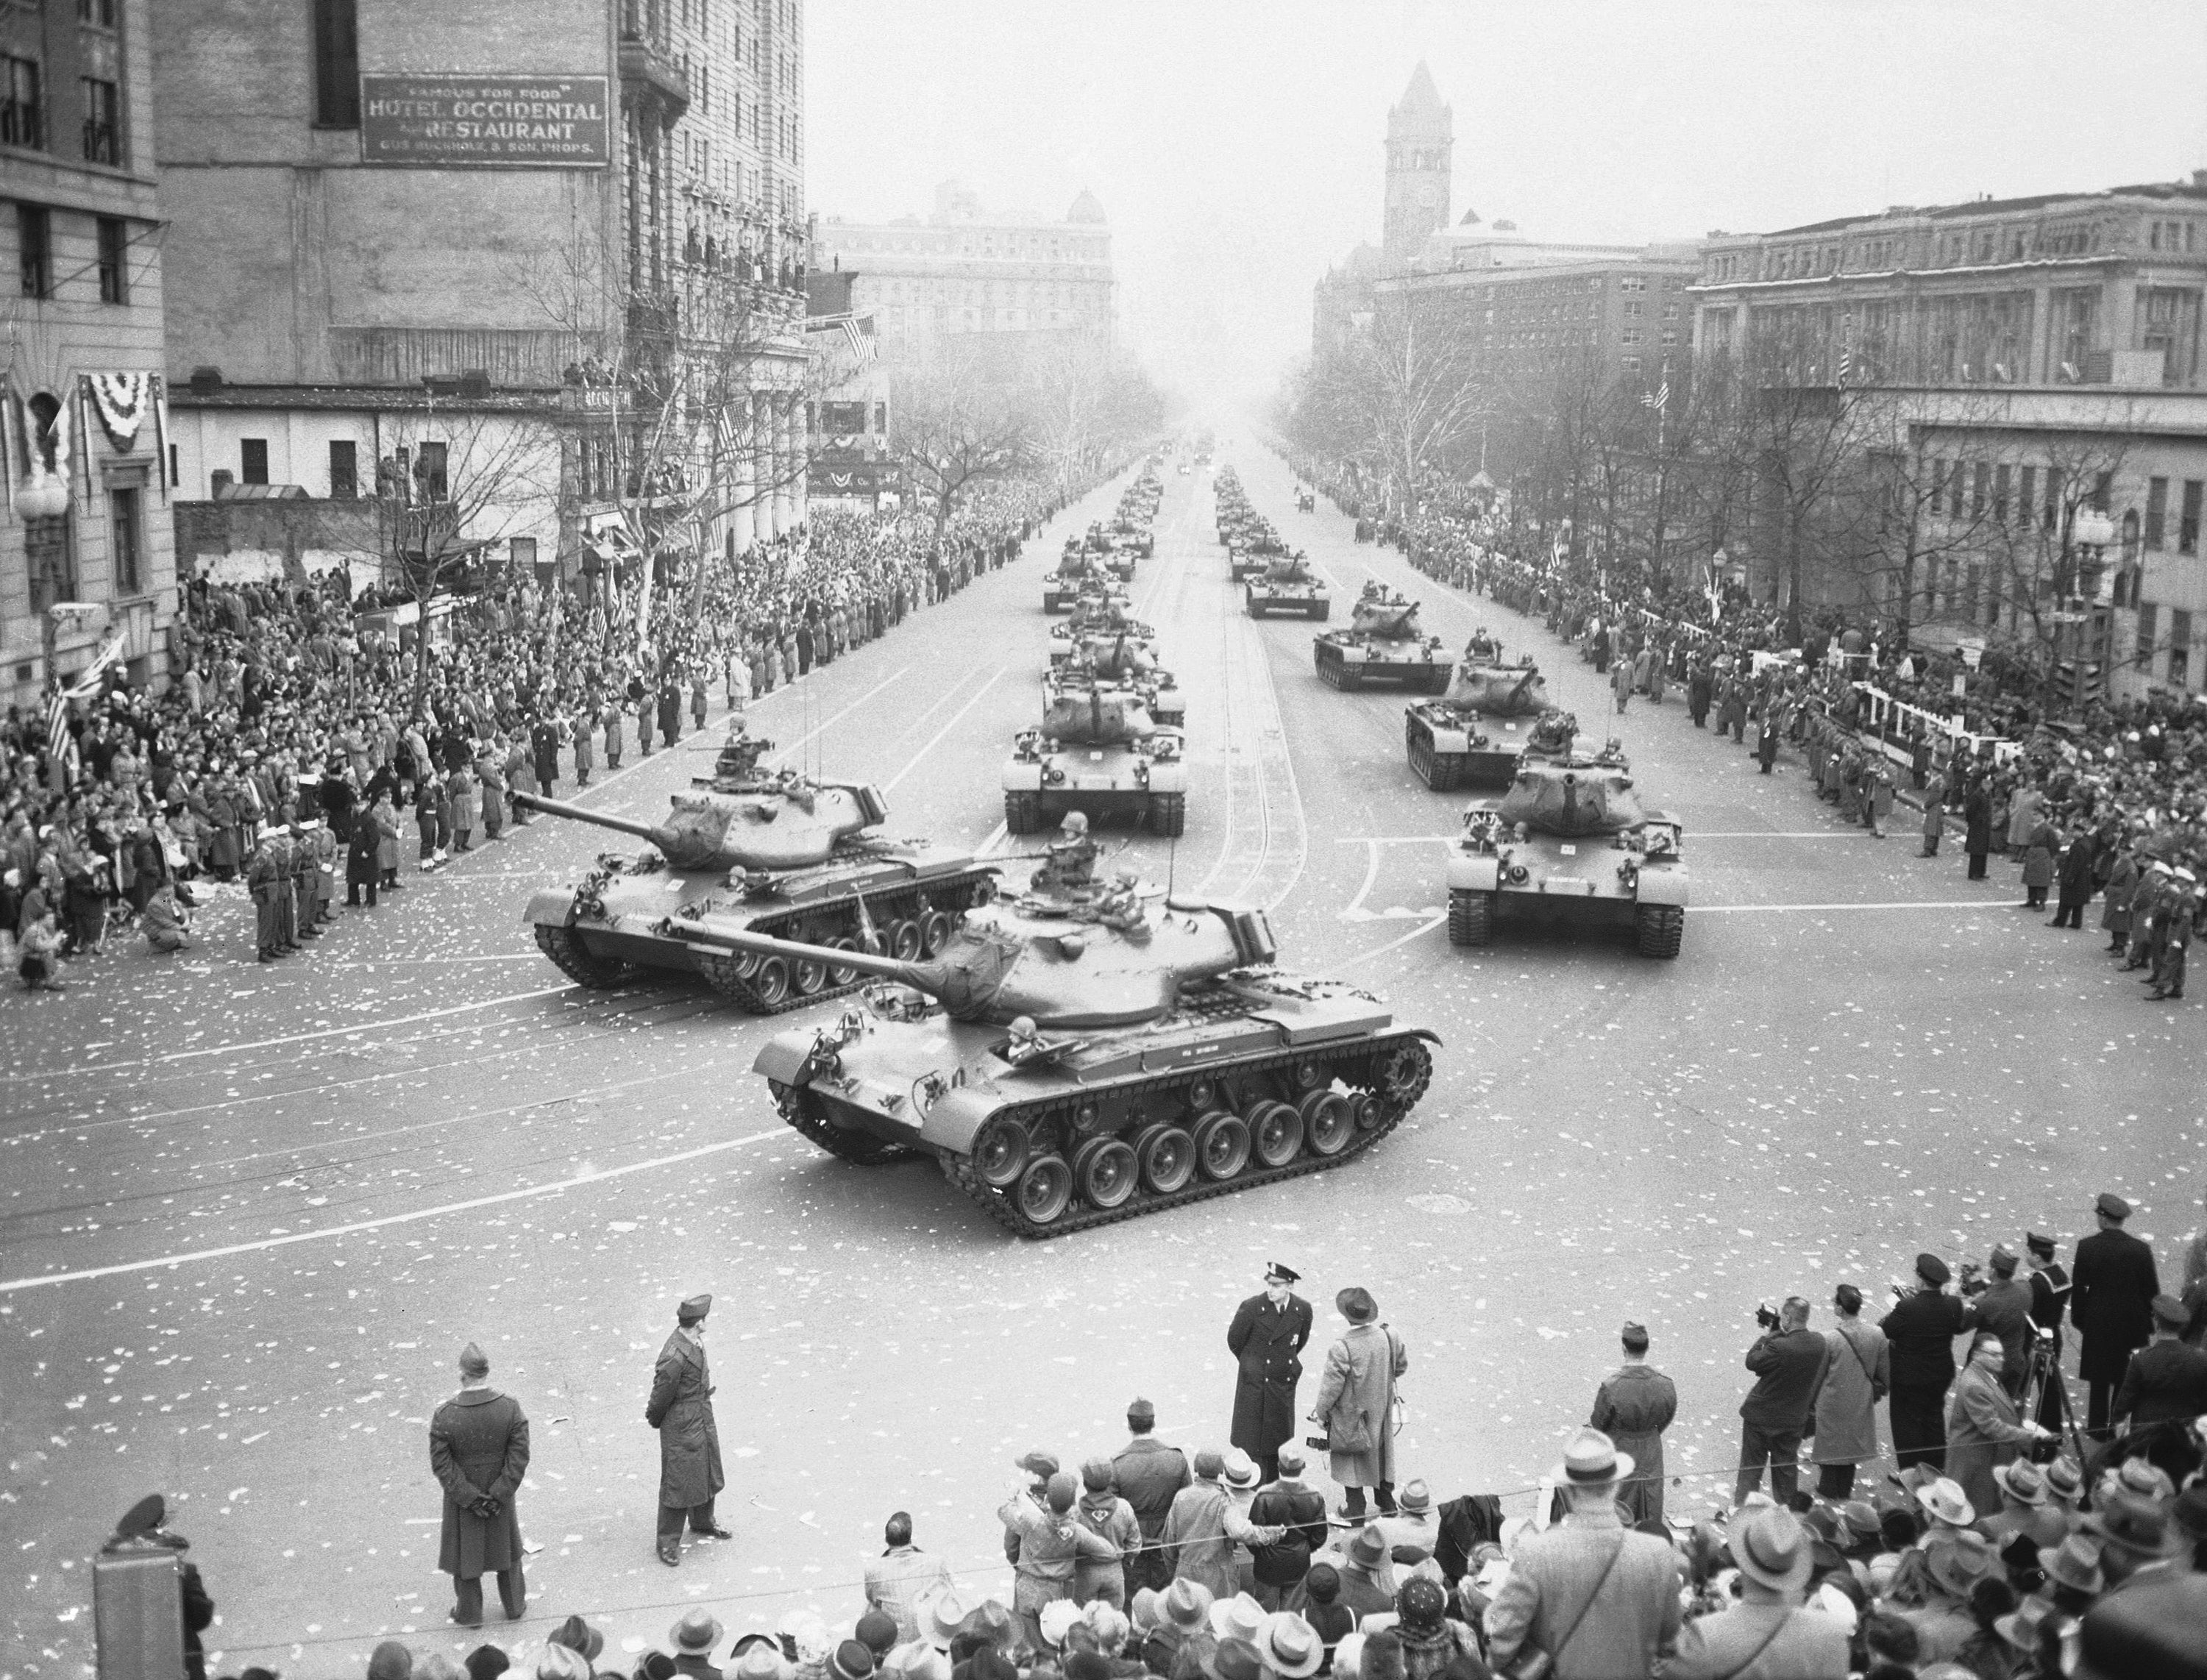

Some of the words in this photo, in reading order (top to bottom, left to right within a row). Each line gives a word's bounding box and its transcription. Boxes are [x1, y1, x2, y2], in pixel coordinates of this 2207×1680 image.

[482, 88, 514, 99] FOR
[369, 100, 444, 118] HOTEL
[453, 101, 603, 121] OCCIDENTAL
[424, 121, 575, 140] RESTAURANT
[491, 142, 502, 152] &
